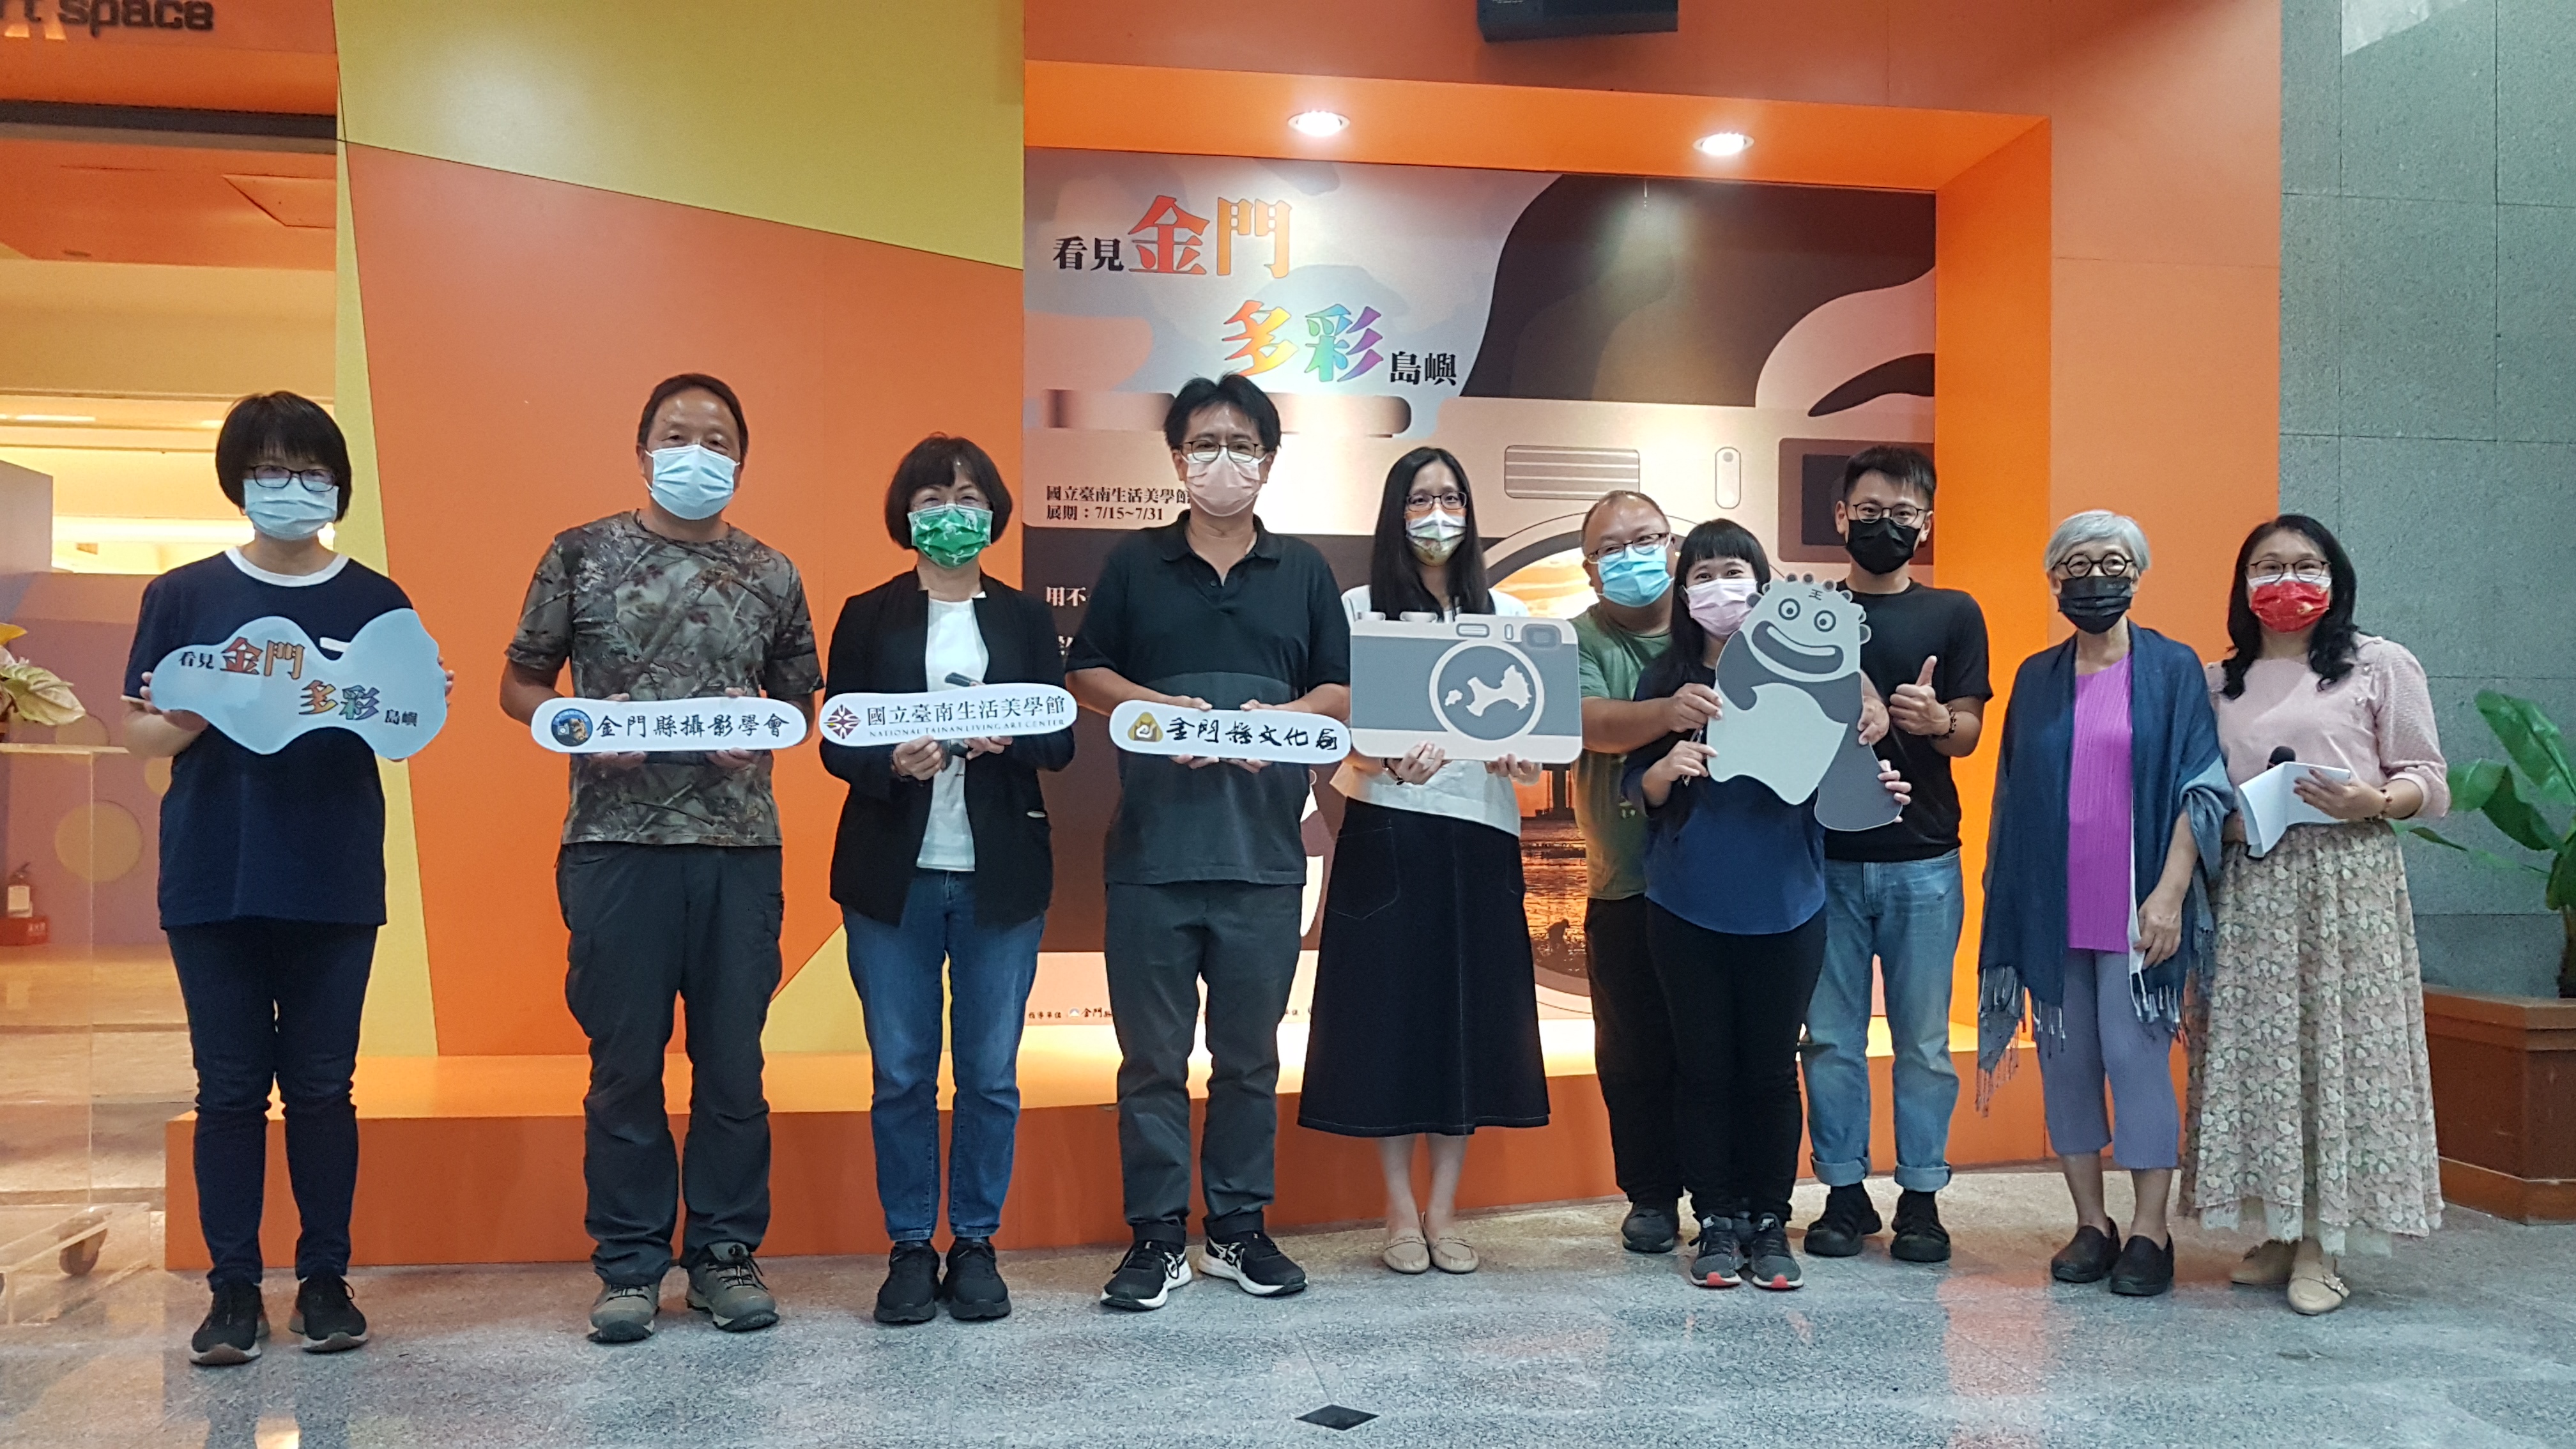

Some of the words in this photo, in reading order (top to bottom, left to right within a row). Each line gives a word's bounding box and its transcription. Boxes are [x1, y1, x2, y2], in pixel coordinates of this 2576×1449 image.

[57, 0, 213, 37] space
[1053, 195, 1292, 279] 看見金門
[1222, 299, 1457, 387] 多彩島嶼
[1046, 485, 1190, 504] 國立臺南生活美學館
[1046, 586, 1090, 606] 用不
[179, 636, 305, 680] 看見金門
[298, 679, 418, 727] 多彩島嶼
[867, 696, 1066, 726] 國立臺南生活美學館
[595, 712, 790, 738] 金門縣攝影學會
[870, 728, 920, 737] NATIONAL
[926, 725, 963, 734] TAINAN
[965, 723, 1000, 732] LIVING
[1025, 719, 1065, 728] CENTER
[1166, 716, 1338, 750] 金門縣文化局
